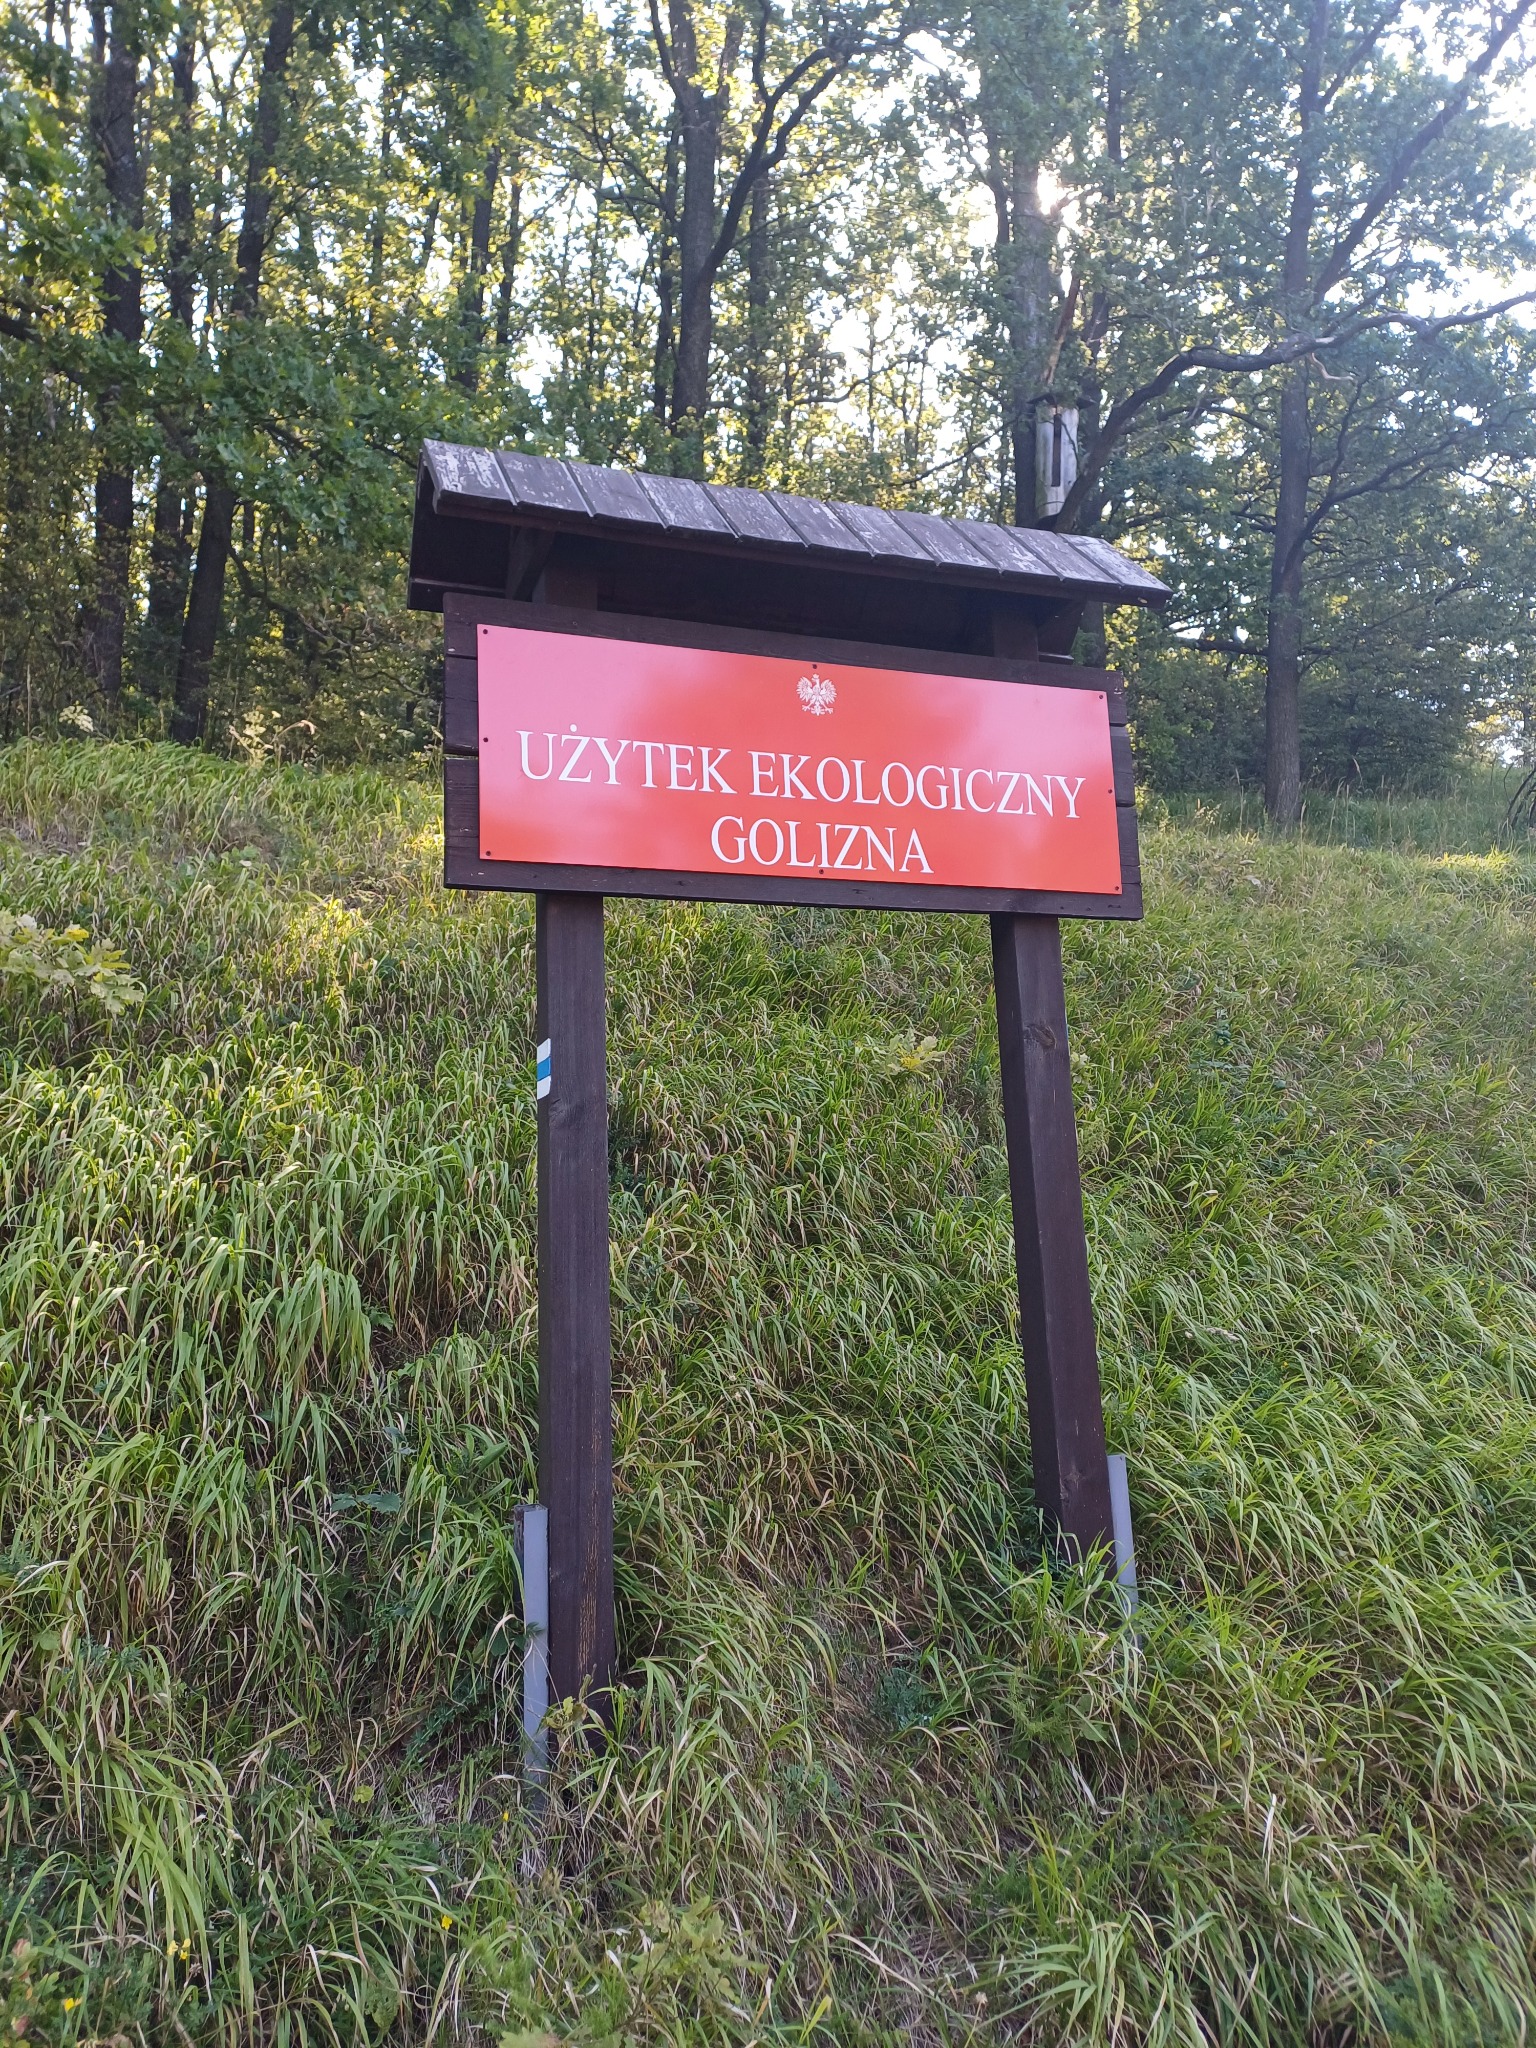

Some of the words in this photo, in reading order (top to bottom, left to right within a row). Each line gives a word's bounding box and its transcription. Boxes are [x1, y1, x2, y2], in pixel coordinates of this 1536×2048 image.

[516, 724, 737, 795] UŻYTEK
[748, 750, 1086, 819] EKOLOGICZNY
[710, 815, 935, 875] GOLIZNA
